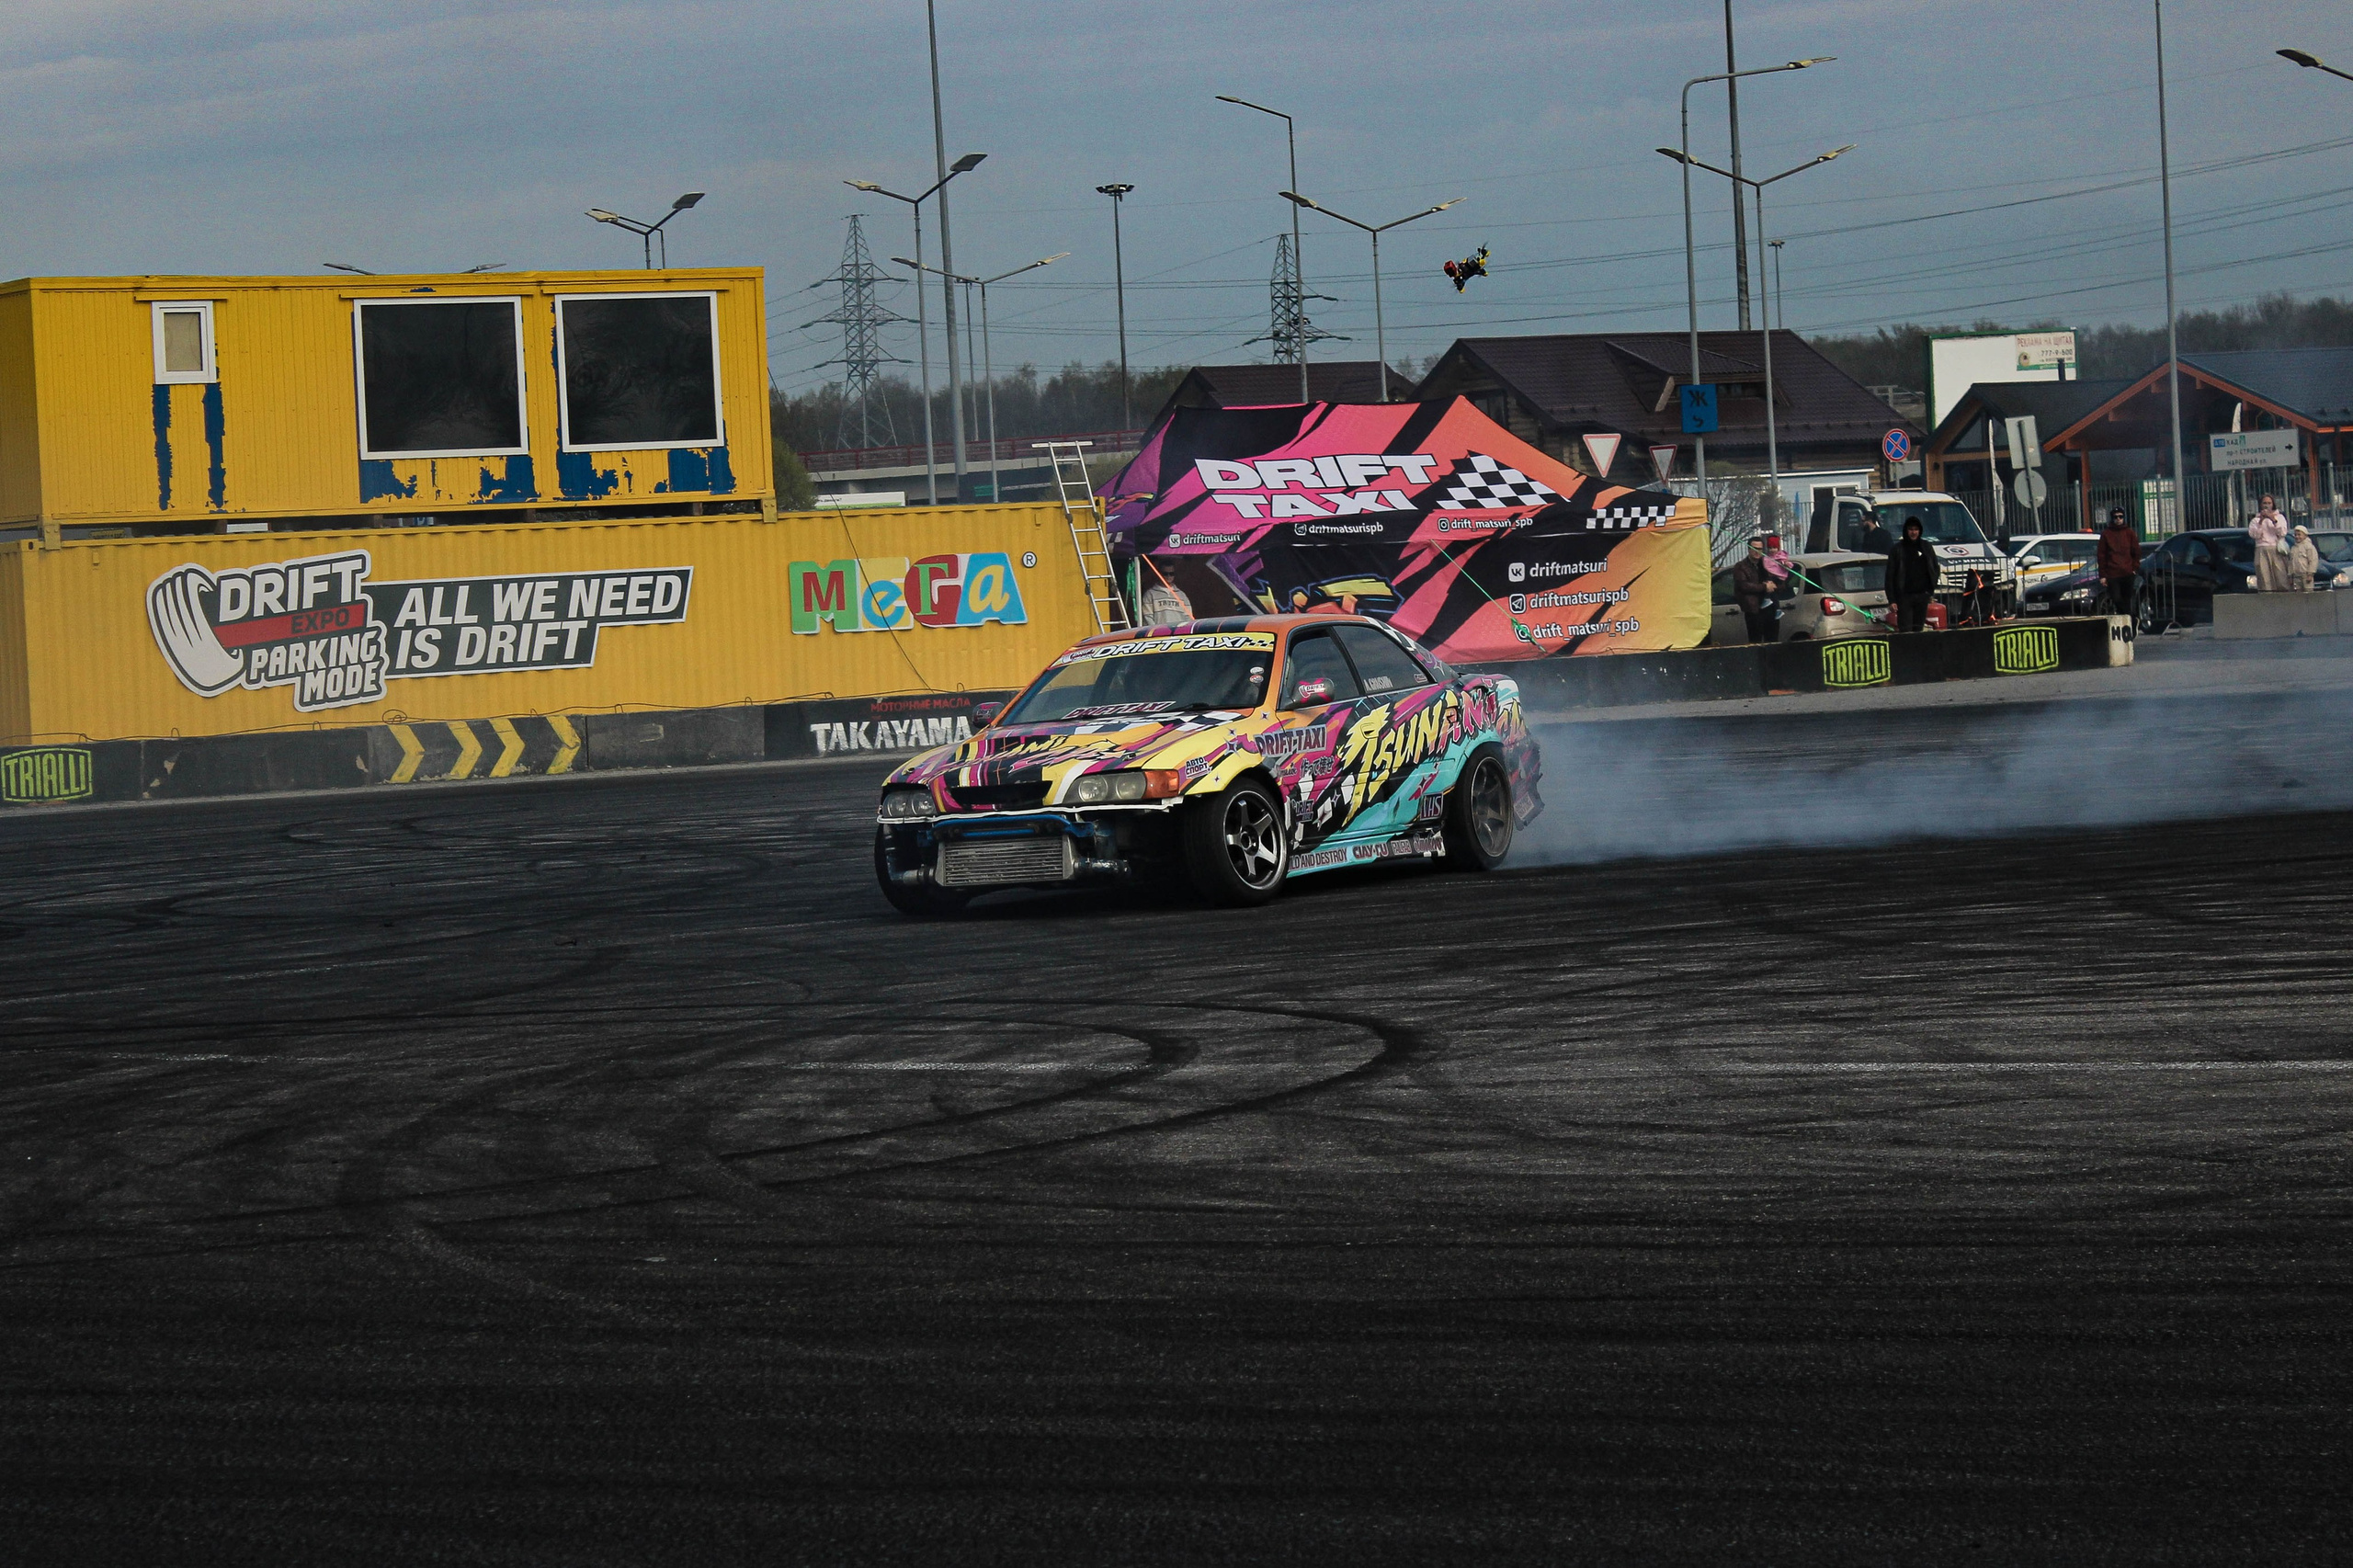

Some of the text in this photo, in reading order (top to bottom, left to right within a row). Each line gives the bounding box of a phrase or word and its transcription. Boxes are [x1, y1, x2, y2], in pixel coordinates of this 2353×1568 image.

[1194, 454, 1438, 490] DRIFT
[1211, 489, 1419, 518] TAXI
[1183, 531, 1241, 545] driftmatsuri
[1529, 558, 1608, 577] driftmatsuri
[219, 559, 363, 623] DRIFT
[393, 574, 683, 628] ALL WE NEED
[1529, 587, 1630, 609] driftmatsurispb
[290, 608, 350, 634] EXPO
[1533, 616, 1640, 641] drift_matsuri_spb
[249, 631, 378, 681] PARKING
[395, 620, 588, 669] IS DRIFT
[1093, 638, 1182, 659] DRIFT
[1183, 636, 1248, 649] TAXI
[1996, 631, 2055, 669] TRIALLI
[1825, 643, 1885, 683] TRIALLI
[302, 662, 381, 703] MODE
[933, 697, 971, 709] МАСЛА
[810, 715, 975, 757] TAKAYAMA
[6, 753, 86, 797] TRIALLI
[1186, 757, 1203, 768] АВТО
[1186, 763, 1209, 776] СПОРТ
[1301, 853, 1315, 868] AND
[1315, 847, 1347, 865] DESTROY
